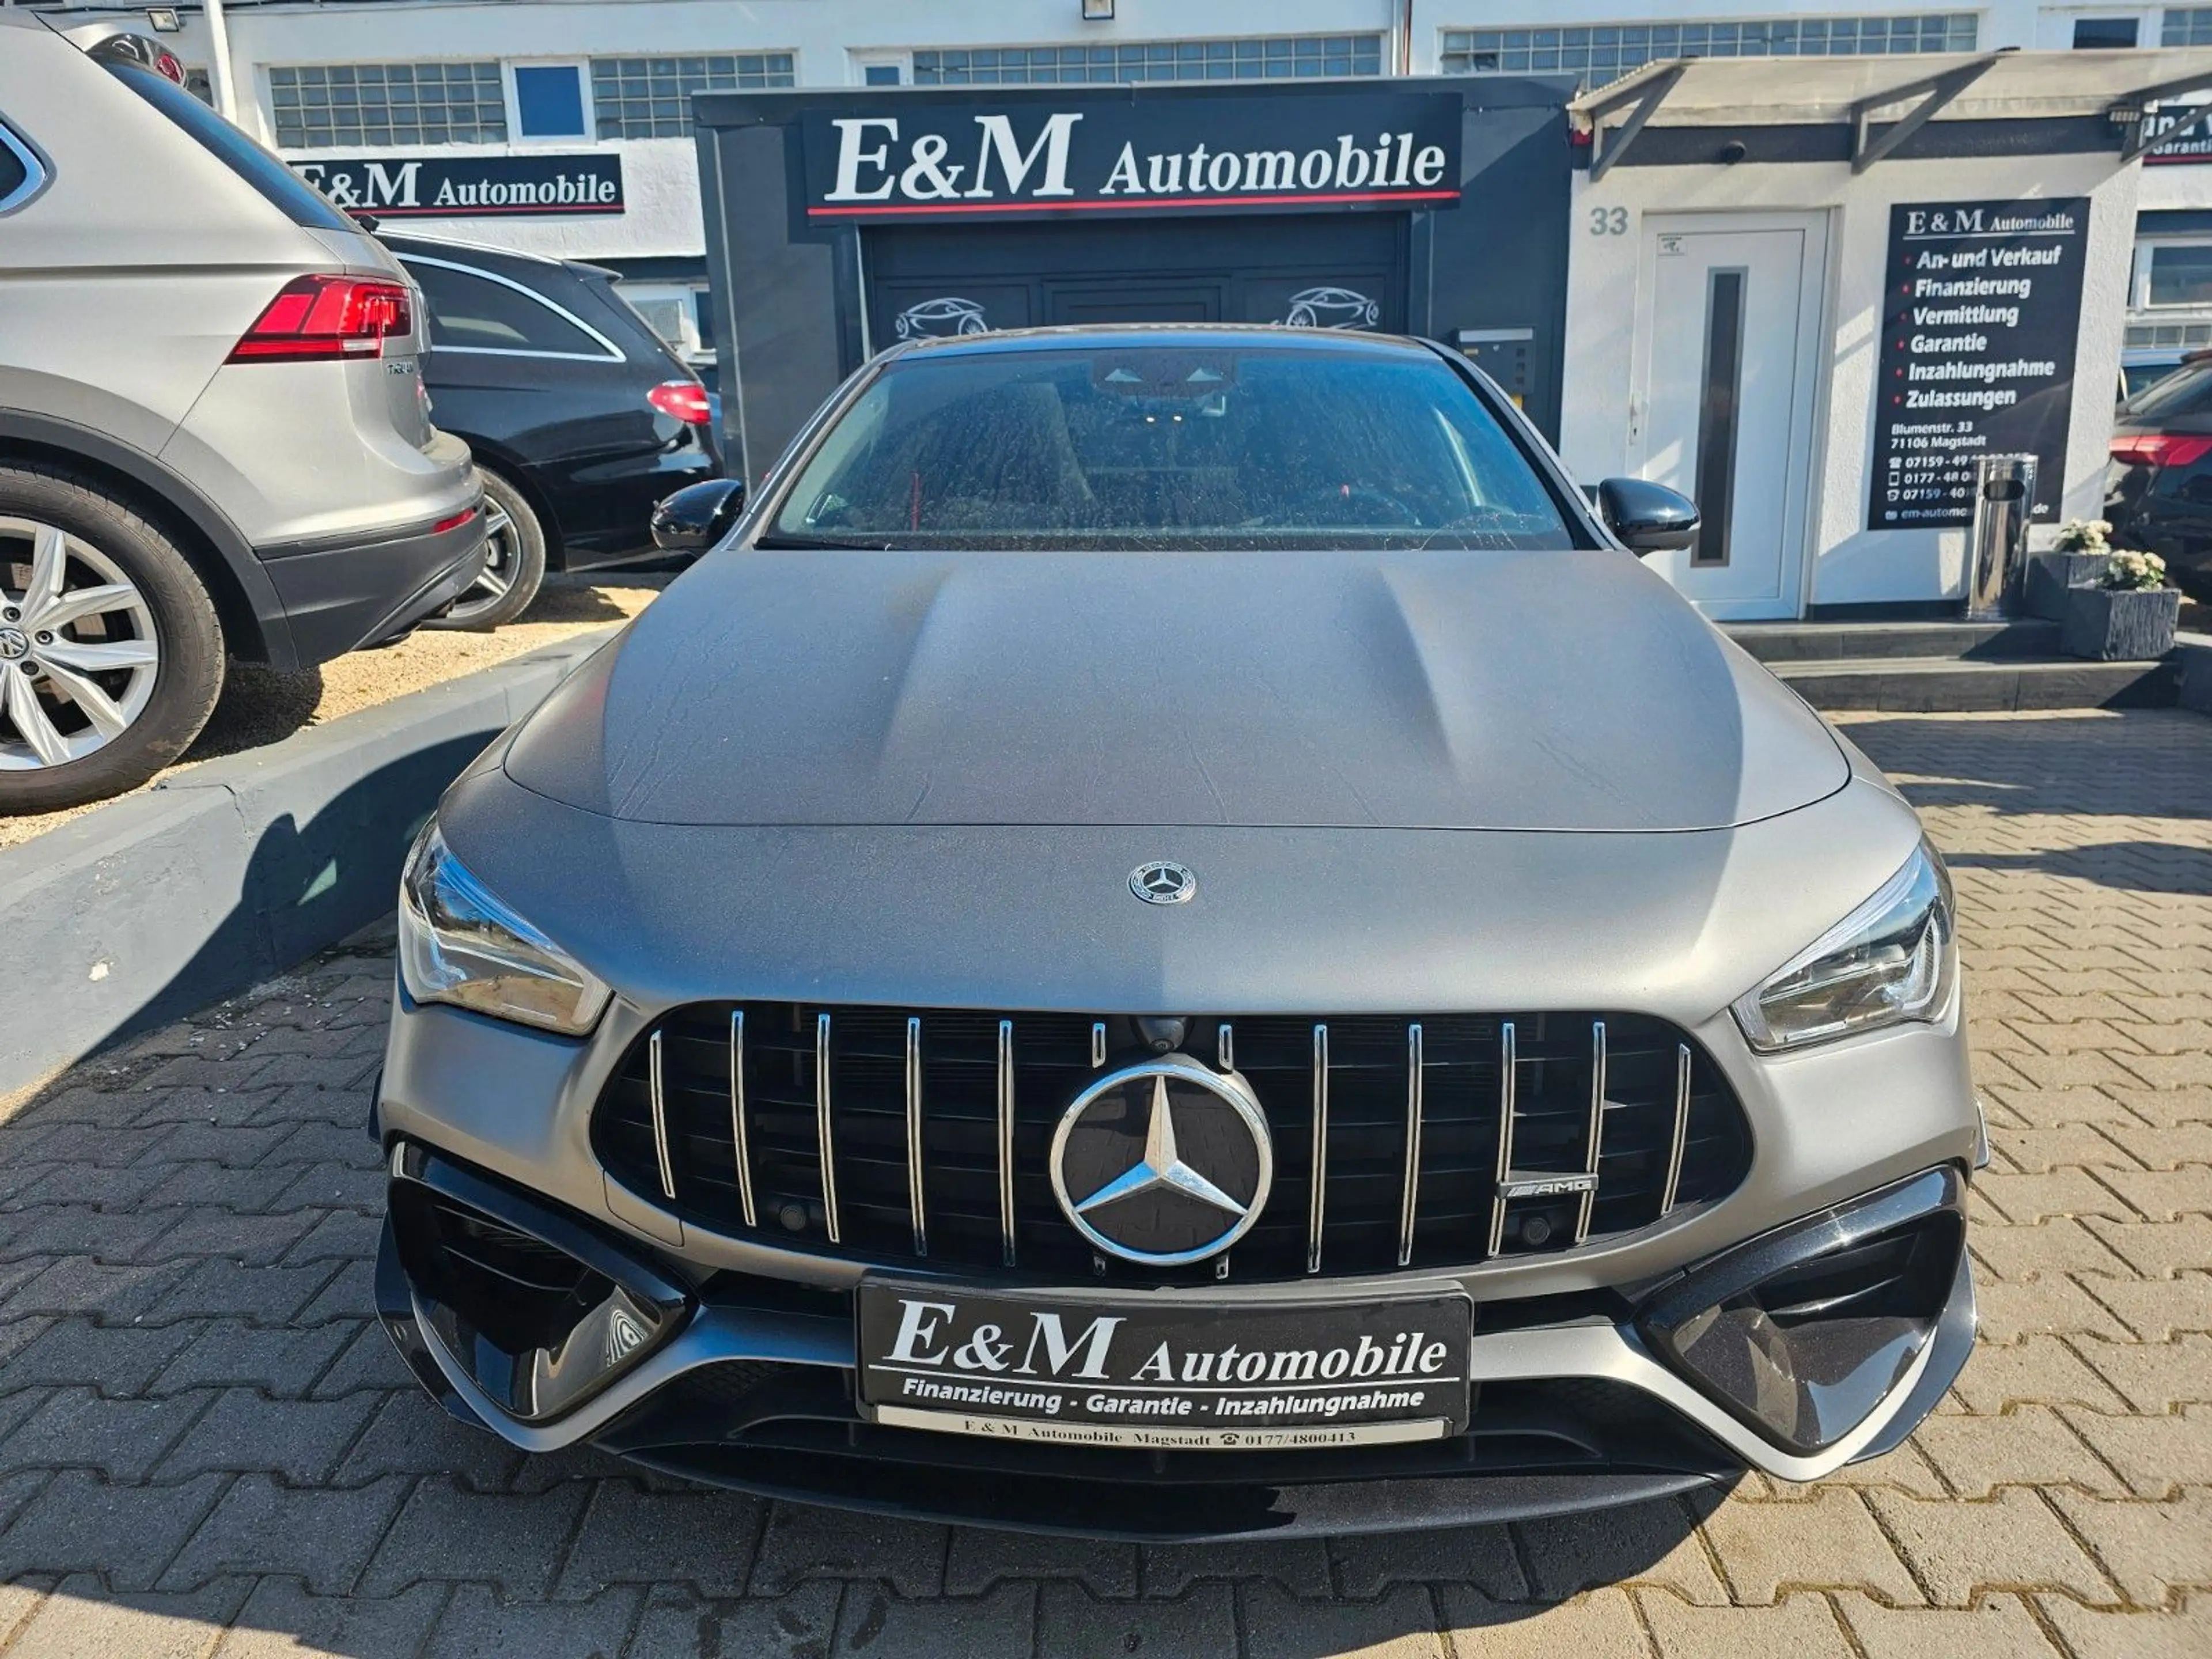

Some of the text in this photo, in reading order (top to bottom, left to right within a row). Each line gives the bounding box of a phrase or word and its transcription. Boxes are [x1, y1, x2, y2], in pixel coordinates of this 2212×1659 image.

[824, 113, 1445, 200] E&M Automobile
[433, 174, 616, 205] Automobile
[1590, 206, 1628, 236] 33
[1907, 209, 2074, 234] E & M Automobile
[1916, 245, 2062, 269] An- und Verkauf
[1915, 276, 2032, 299] Finanzierung
[1913, 305, 2019, 327] Vermittlung
[1911, 332, 1987, 353] Garantie
[1908, 359, 2055, 384] Inzahlungnahme
[1906, 389, 2017, 411] Zulassungen
[1891, 421, 1973, 435] Blumenstr. 33
[1891, 435, 1987, 450] 71106 Magstadt
[1905, 456, 1944, 468] 07159
[1904, 472, 1935, 484] 0177
[1902, 488, 1941, 500] 07159
[882, 1298, 1447, 1382] E&M Automobile
[903, 1378, 1062, 1414] Finanzierung
[1086, 1394, 1192, 1415] Garantie
[1215, 1391, 1425, 1416] Inzahlungnahme
[1029, 1427, 1122, 1442] Automobile
[1133, 1433, 1210, 1446] Magstadt
[1245, 1431, 1356, 1446] 0177/4800413
